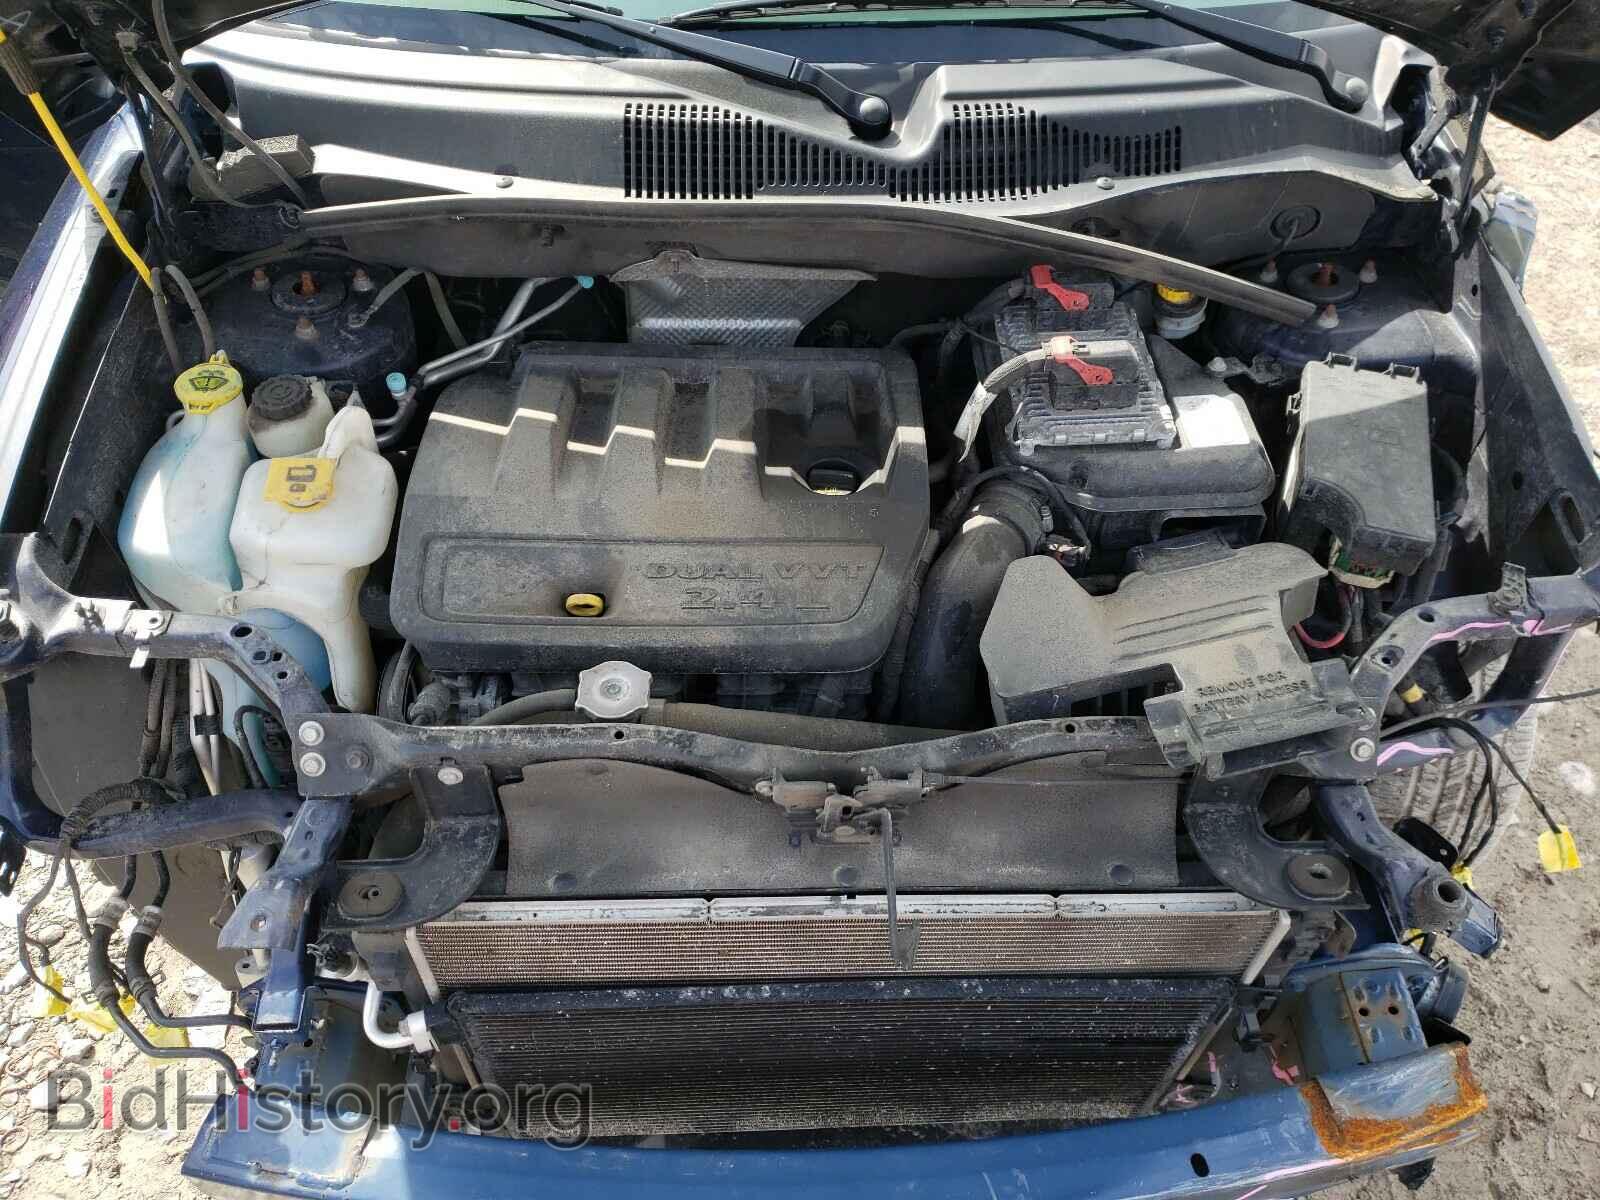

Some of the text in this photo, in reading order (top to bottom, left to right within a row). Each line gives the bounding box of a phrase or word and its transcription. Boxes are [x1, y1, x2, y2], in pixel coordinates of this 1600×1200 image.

[646, 562, 868, 580] DUAL VVT
[680, 587, 776, 610] 2.4
[1192, 679, 1311, 713] BATTERY ACCESS
[1196, 670, 1288, 698] REMOVE FOR
